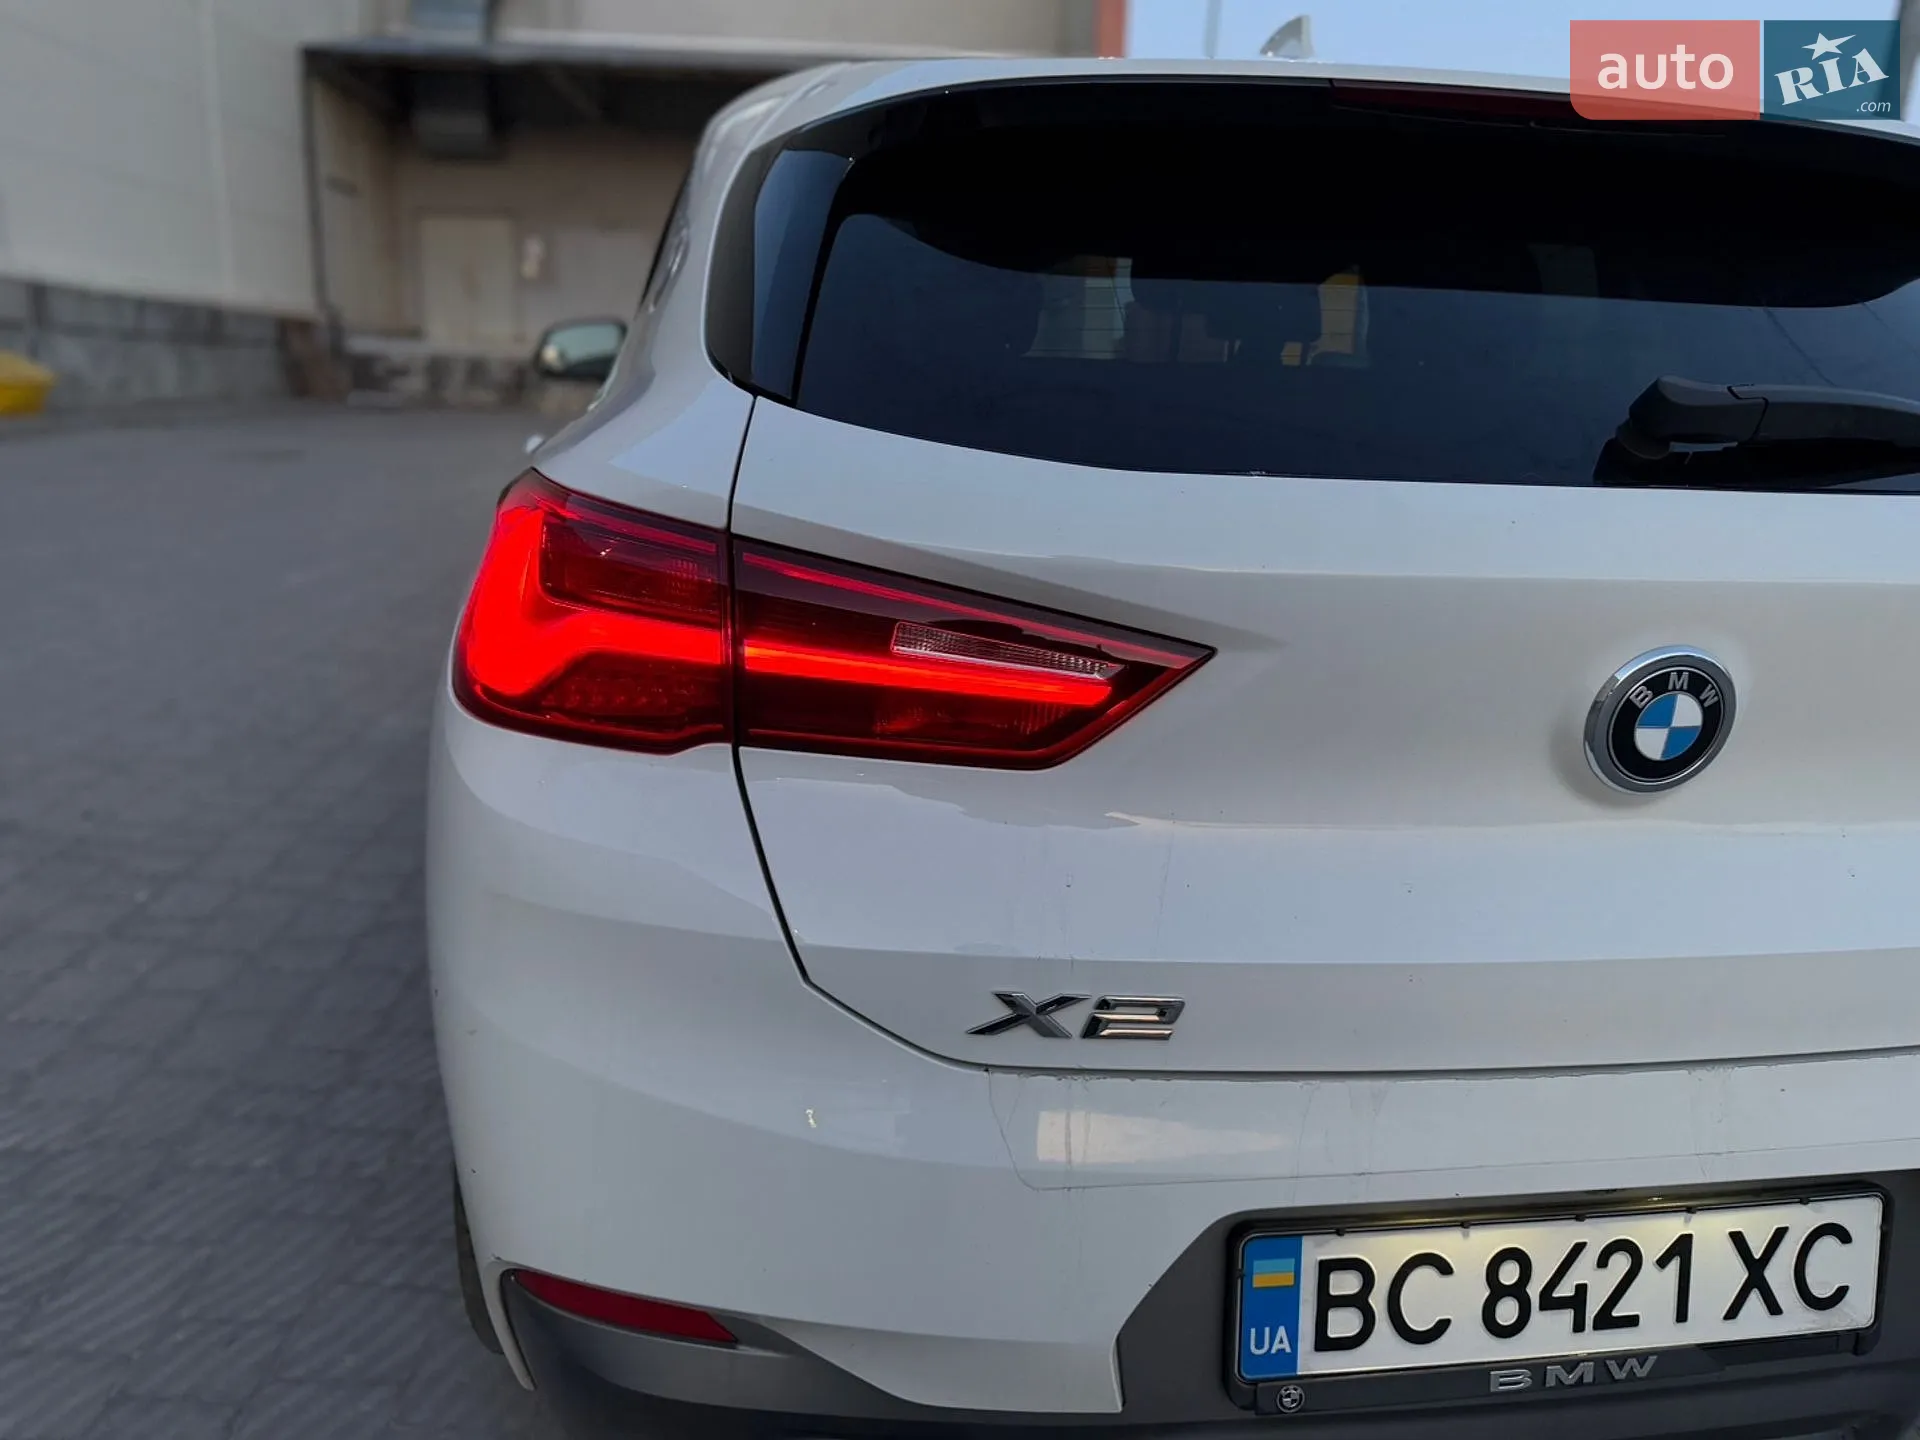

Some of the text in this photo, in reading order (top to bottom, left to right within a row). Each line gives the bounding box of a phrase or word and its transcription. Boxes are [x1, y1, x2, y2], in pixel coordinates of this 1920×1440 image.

[1629, 671, 1719, 709] BMW
[966, 991, 1186, 1040] X2
[1314, 1222, 1853, 1352] BC 8421 XC
[1249, 1328, 1292, 1356] UA
[1489, 1355, 1658, 1393] BMW
